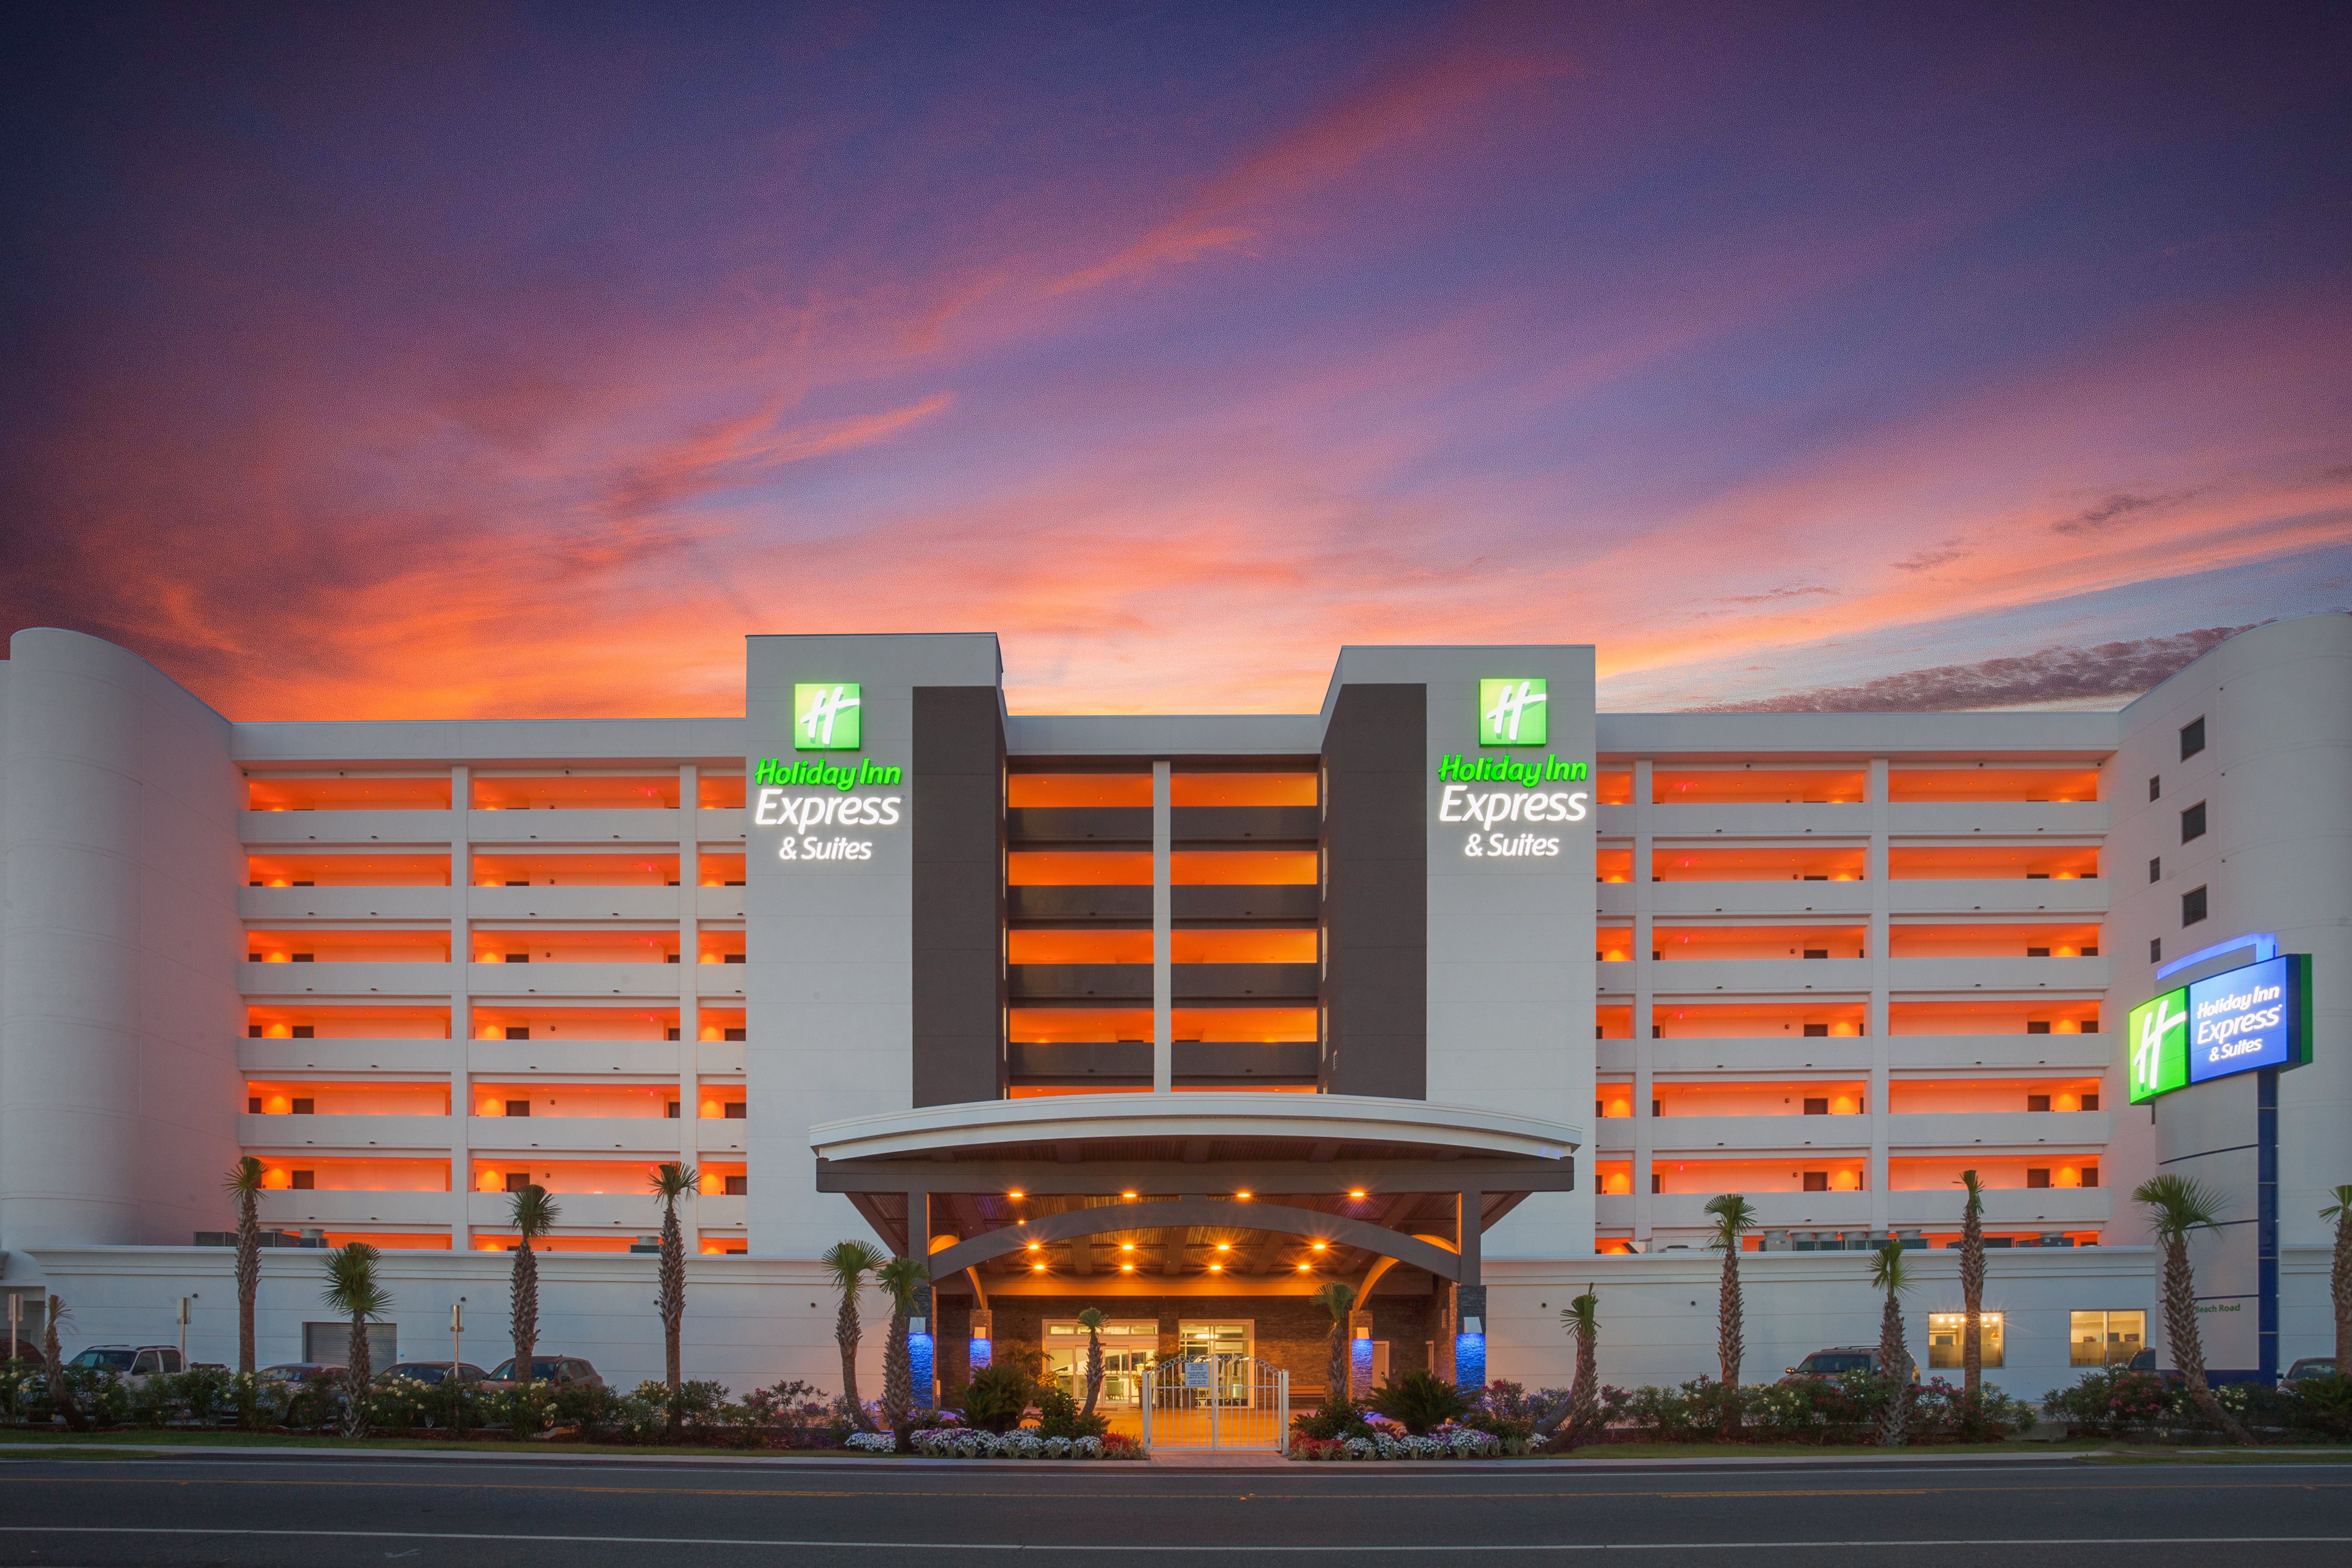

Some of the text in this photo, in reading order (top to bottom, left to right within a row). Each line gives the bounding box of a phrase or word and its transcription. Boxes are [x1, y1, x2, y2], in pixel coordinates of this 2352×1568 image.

[755, 758, 902, 792] Holiday Inn
[1438, 754, 1588, 788] Holiday Inn
[755, 789, 901, 835] Express
[1439, 785, 1587, 831] Express
[779, 836, 872, 860] & Suites
[1465, 833, 1560, 856] & Suites
[2196, 986, 2280, 1019] Holiday Inn
[2197, 1007, 2280, 1045] Express
[2209, 1038, 2262, 1062] & Suites
[2195, 1303, 2240, 1313] Beach Road
